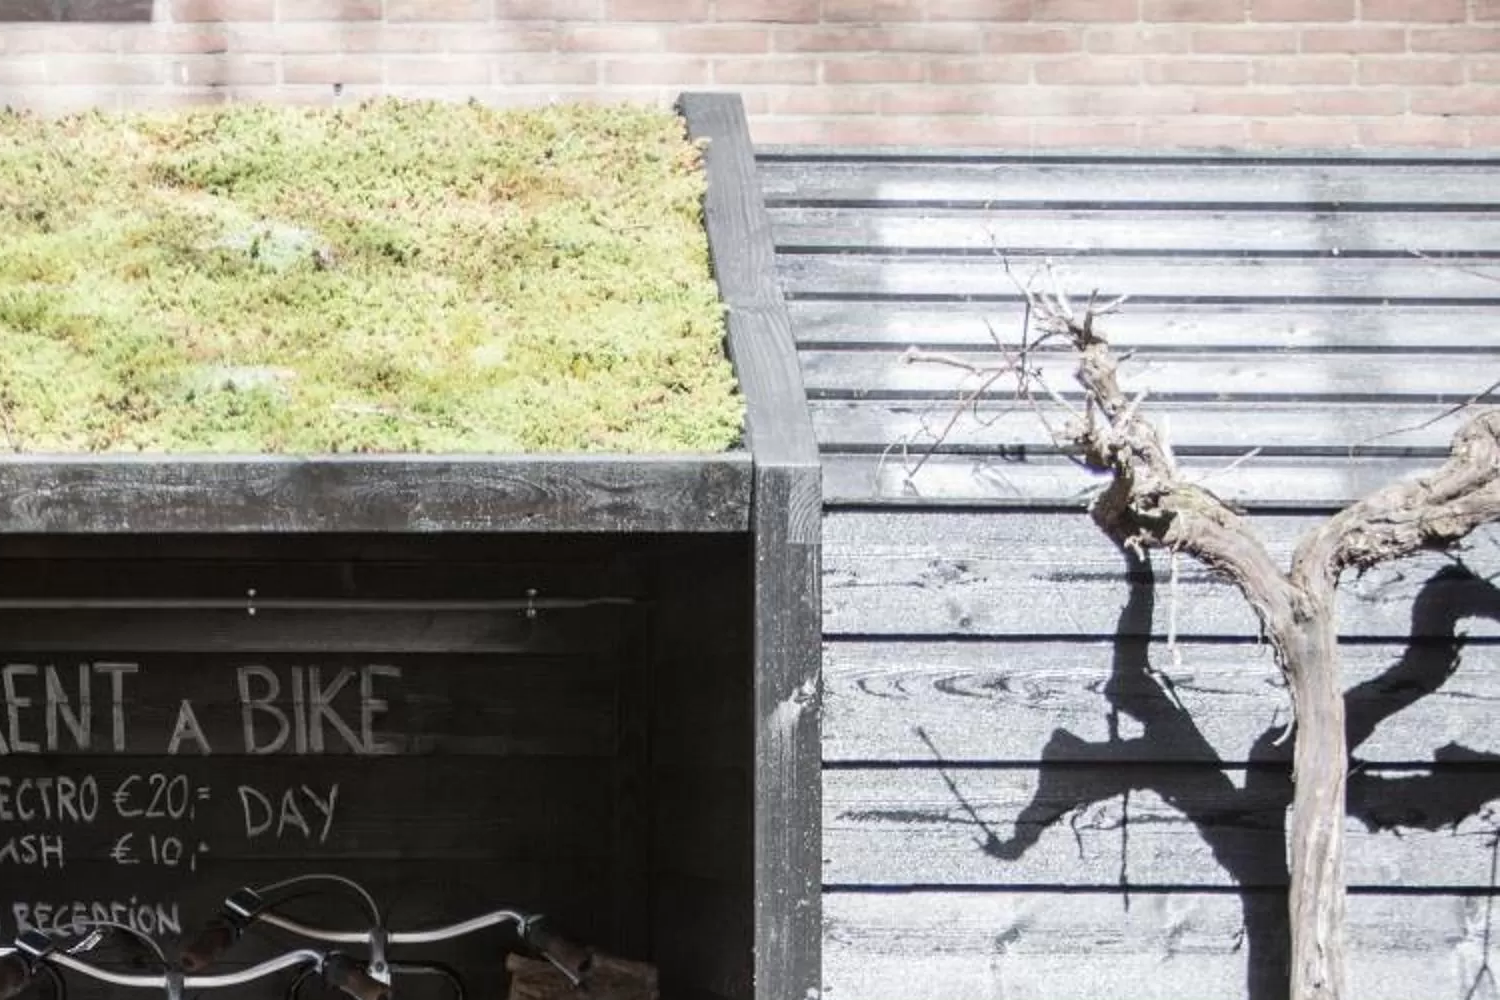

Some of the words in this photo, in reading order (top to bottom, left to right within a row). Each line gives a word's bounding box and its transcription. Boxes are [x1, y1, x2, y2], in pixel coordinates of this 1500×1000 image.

[167, 700, 212, 754] A
[236, 663, 401, 755] BIKE
[237, 782, 339, 842] DAY
